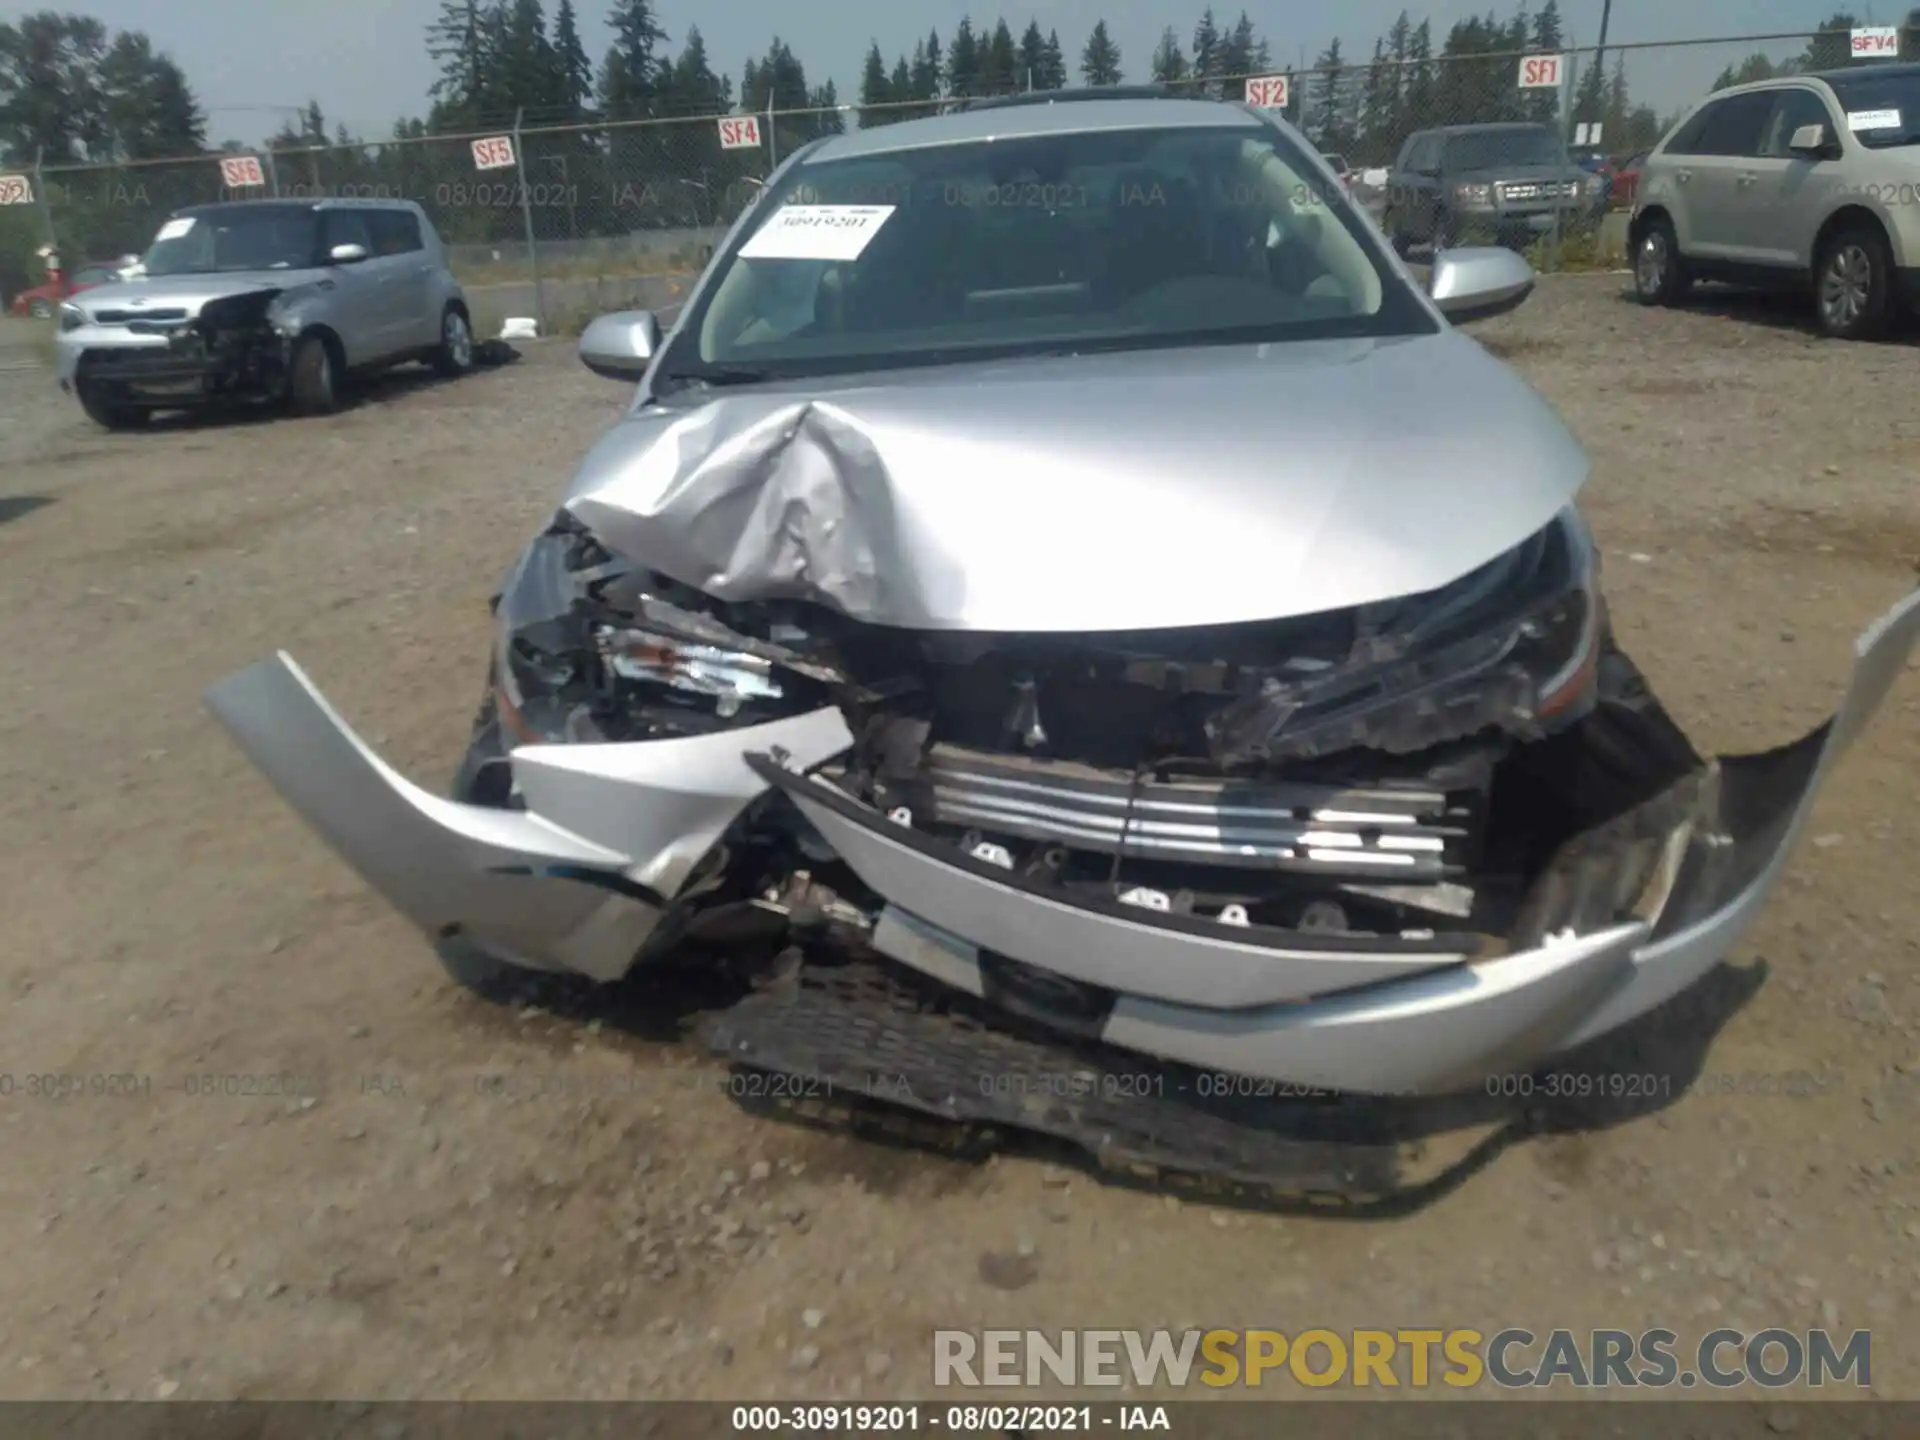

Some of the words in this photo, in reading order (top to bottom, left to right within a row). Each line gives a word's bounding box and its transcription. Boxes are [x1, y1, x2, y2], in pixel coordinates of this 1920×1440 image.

[1851, 35, 1895, 51] SFV4
[1524, 58, 1557, 84] SF1
[1249, 79, 1285, 106] SF2
[721, 119, 757, 145] SF4
[475, 140, 511, 165] SF5
[225, 160, 259, 183] SF6
